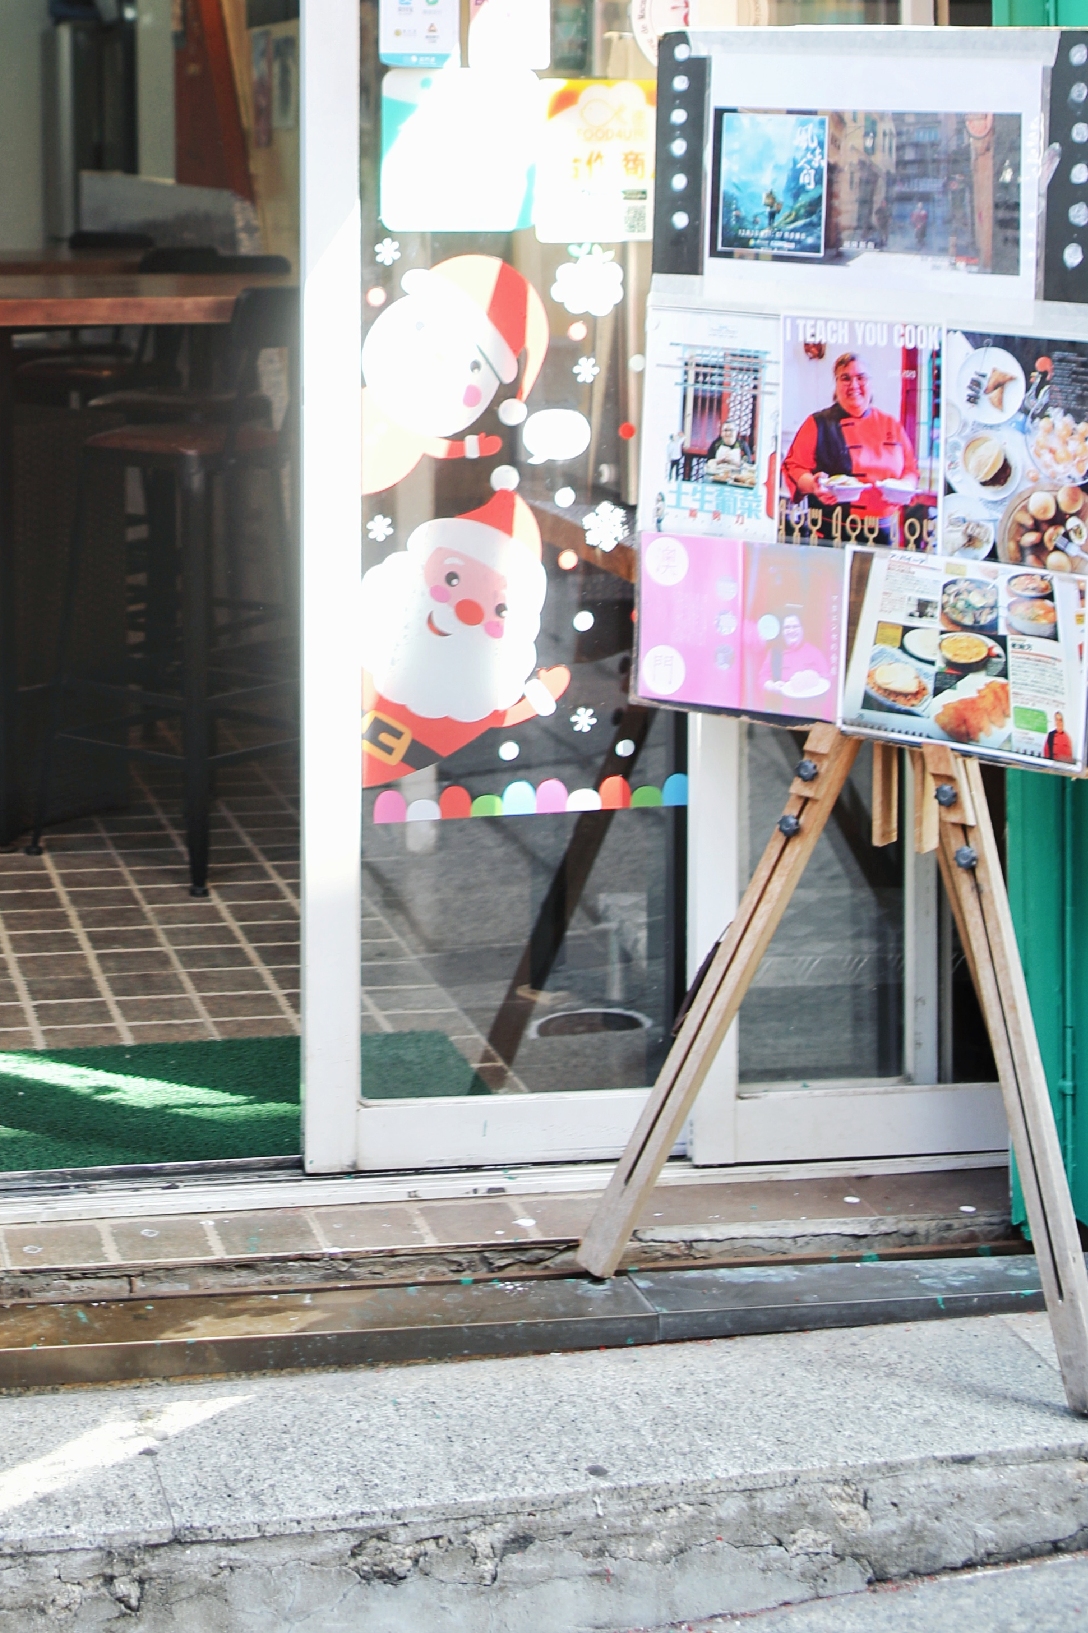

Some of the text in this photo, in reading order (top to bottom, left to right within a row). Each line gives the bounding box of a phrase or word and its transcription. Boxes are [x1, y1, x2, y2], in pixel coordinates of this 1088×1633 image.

[785, 319, 940, 350] I TEACH YOU COOK
